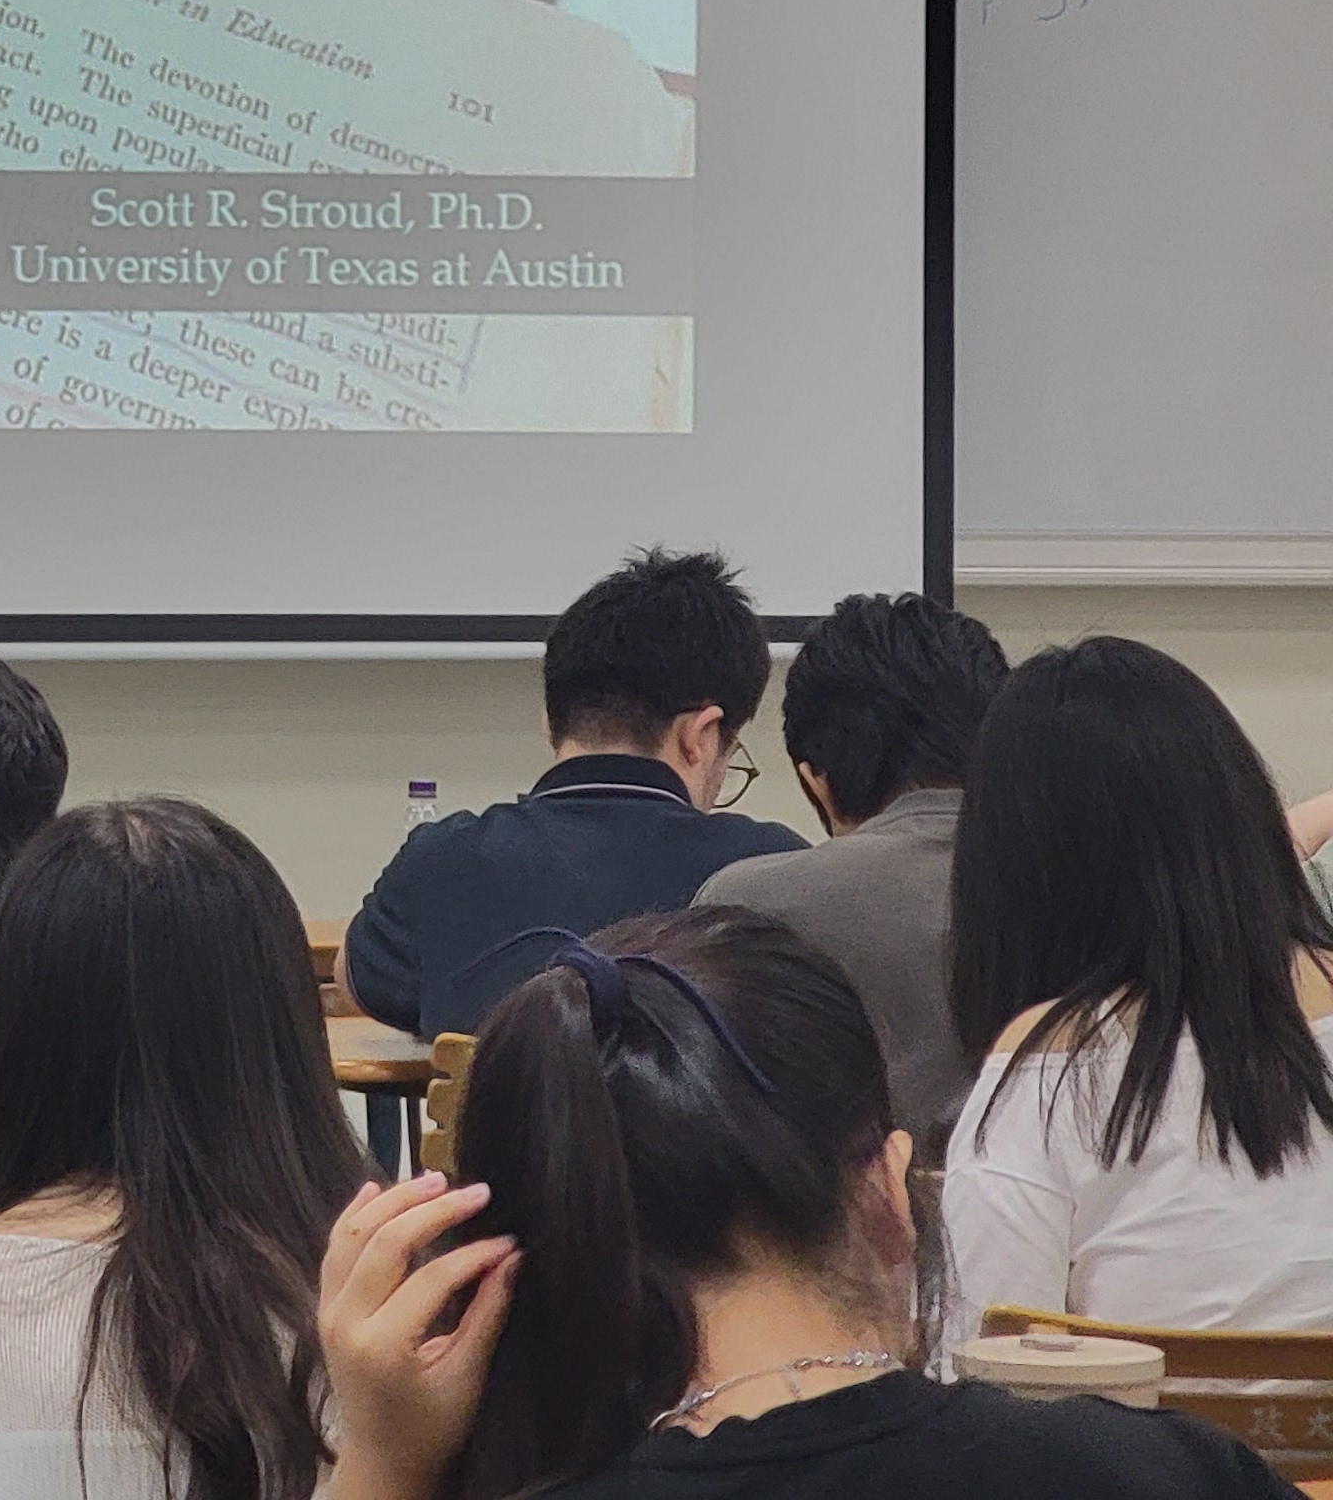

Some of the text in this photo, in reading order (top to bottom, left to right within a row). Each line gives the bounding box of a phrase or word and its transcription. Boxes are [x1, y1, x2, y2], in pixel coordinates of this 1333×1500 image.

[225, 6, 376, 81] Education
[81, 27, 136, 71] The
[148, 56, 272, 122] devotion
[286, 109, 318, 137] of
[29, 94, 100, 137] upon
[79, 64, 134, 109] The
[145, 98, 295, 168] superficial
[90, 187, 544, 236] Scott R. Stroud, Ph.D.
[9, 243, 625, 297] University of Texas at Austin
[13, 353, 51, 385] of
[55, 315, 83, 350] is
[94, 339, 113, 362] a
[128, 345, 232, 404] deeper
[179, 317, 258, 369] these
[269, 355, 322, 394] can
[335, 372, 374, 411] be
[316, 332, 337, 354] a
[347, 343, 451, 388] substi-
[4, 400, 43, 429] of
